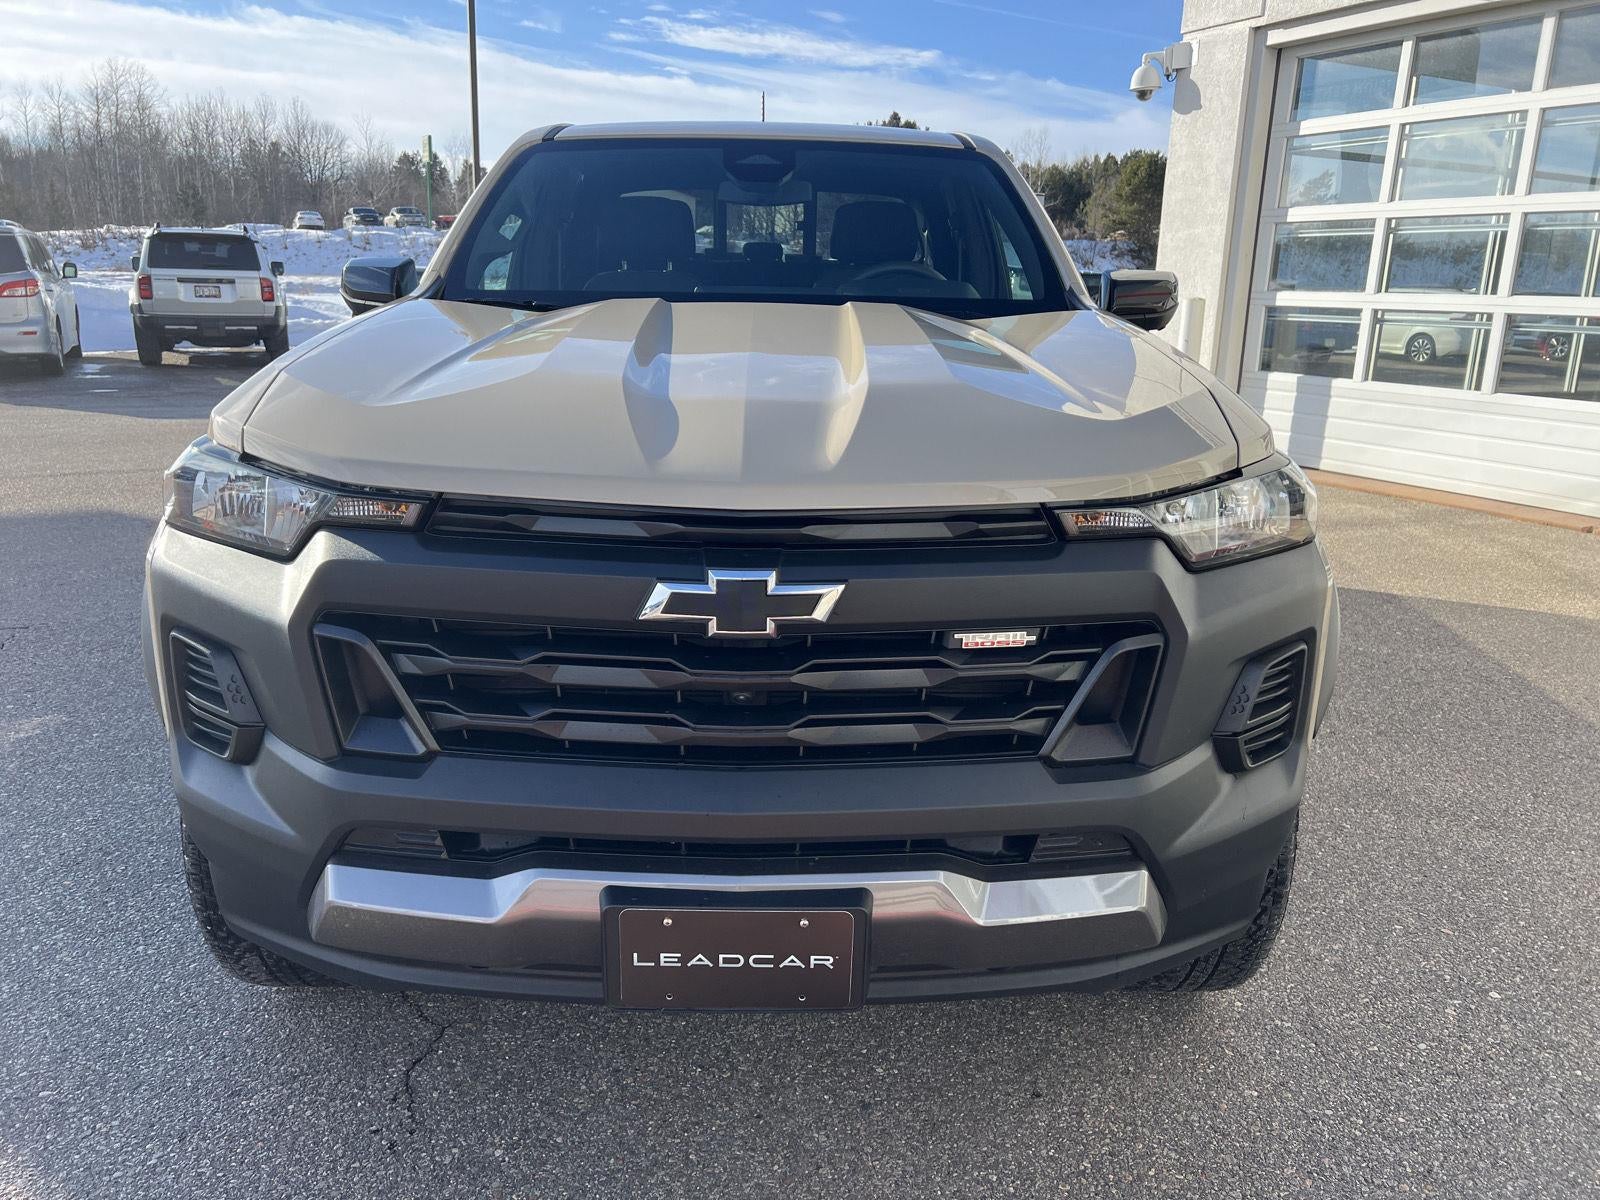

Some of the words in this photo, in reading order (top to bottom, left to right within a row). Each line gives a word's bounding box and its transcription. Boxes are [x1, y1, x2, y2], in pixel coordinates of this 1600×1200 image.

[954, 632, 1036, 641] TRAIL
[962, 640, 1026, 648] BOSS
[633, 952, 834, 969] LEADCAR
